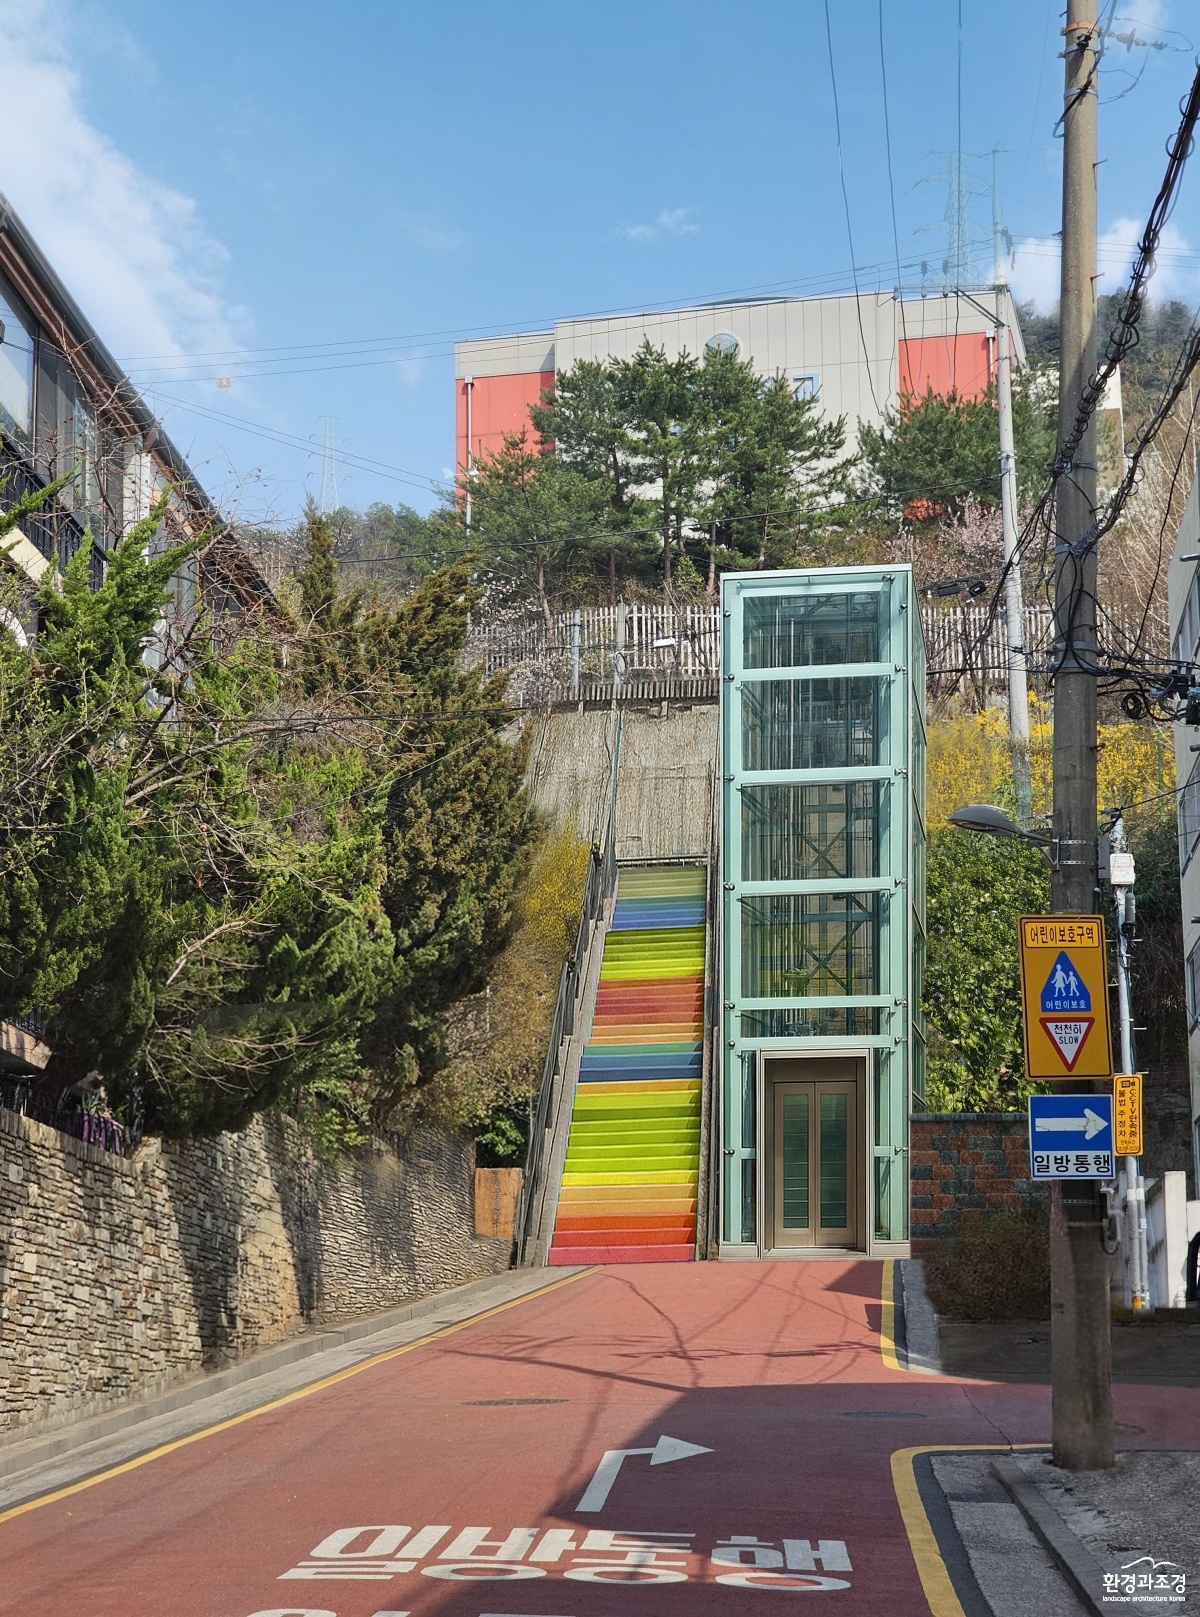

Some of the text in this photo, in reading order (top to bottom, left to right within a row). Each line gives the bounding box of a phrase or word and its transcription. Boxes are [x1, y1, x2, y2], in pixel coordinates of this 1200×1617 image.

[1030, 925, 1095, 945] 어린이보호구역
[1045, 999, 1087, 1010] 어린이보호
[1054, 1024, 1082, 1035] 천천히
[1058, 1035, 1080, 1045] SLOW
[1034, 1154, 1111, 1174] 일방통행
[276, 1524, 853, 1592] 일방통행
